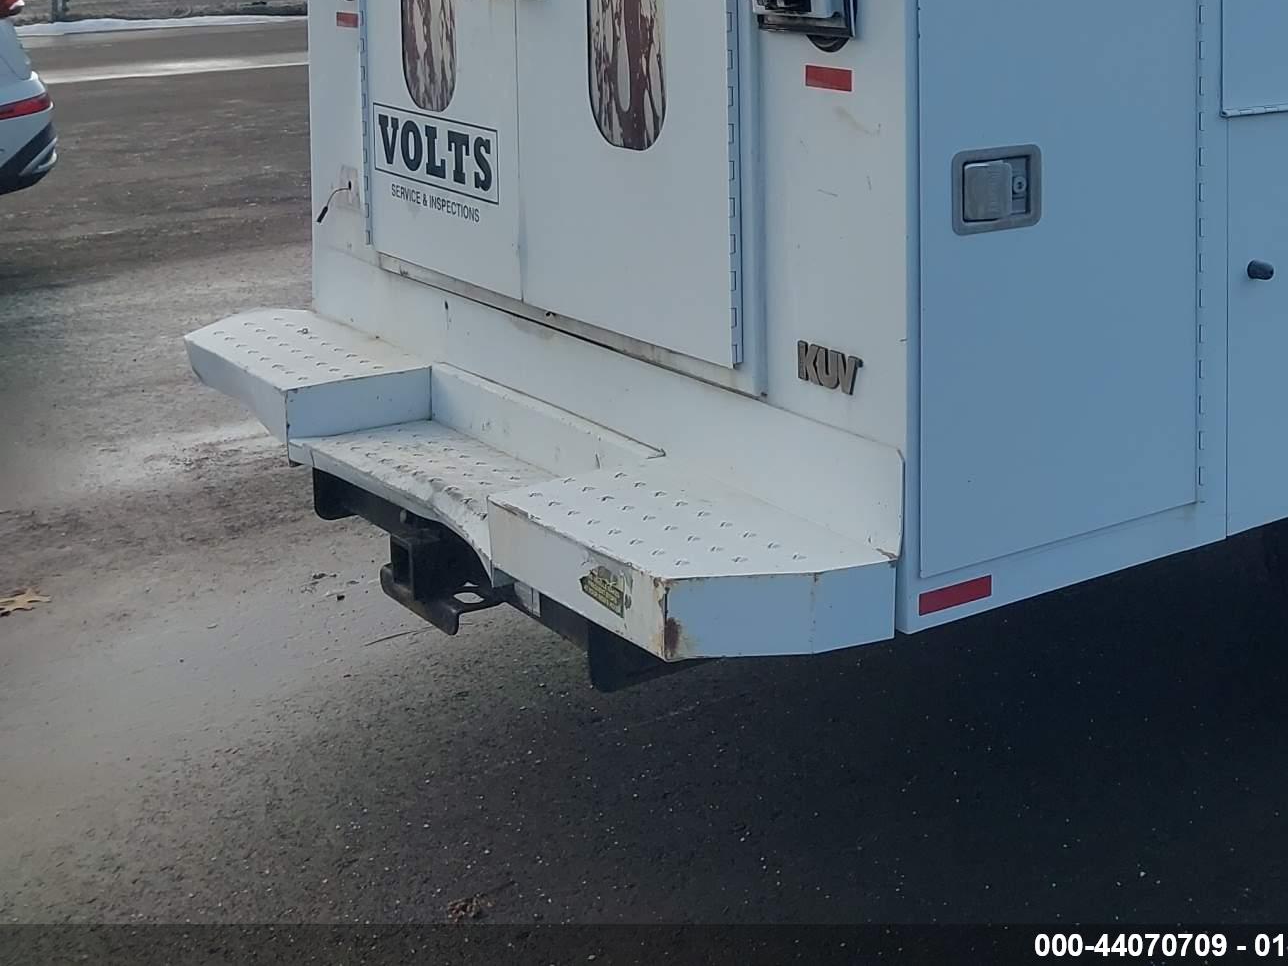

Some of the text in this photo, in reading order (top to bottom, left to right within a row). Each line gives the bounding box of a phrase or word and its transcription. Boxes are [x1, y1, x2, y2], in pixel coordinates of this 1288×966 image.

[378, 114, 492, 192] VOLTS
[391, 183, 480, 223] SERVICE & INSPECTIONS
[797, 339, 864, 395] KUV
